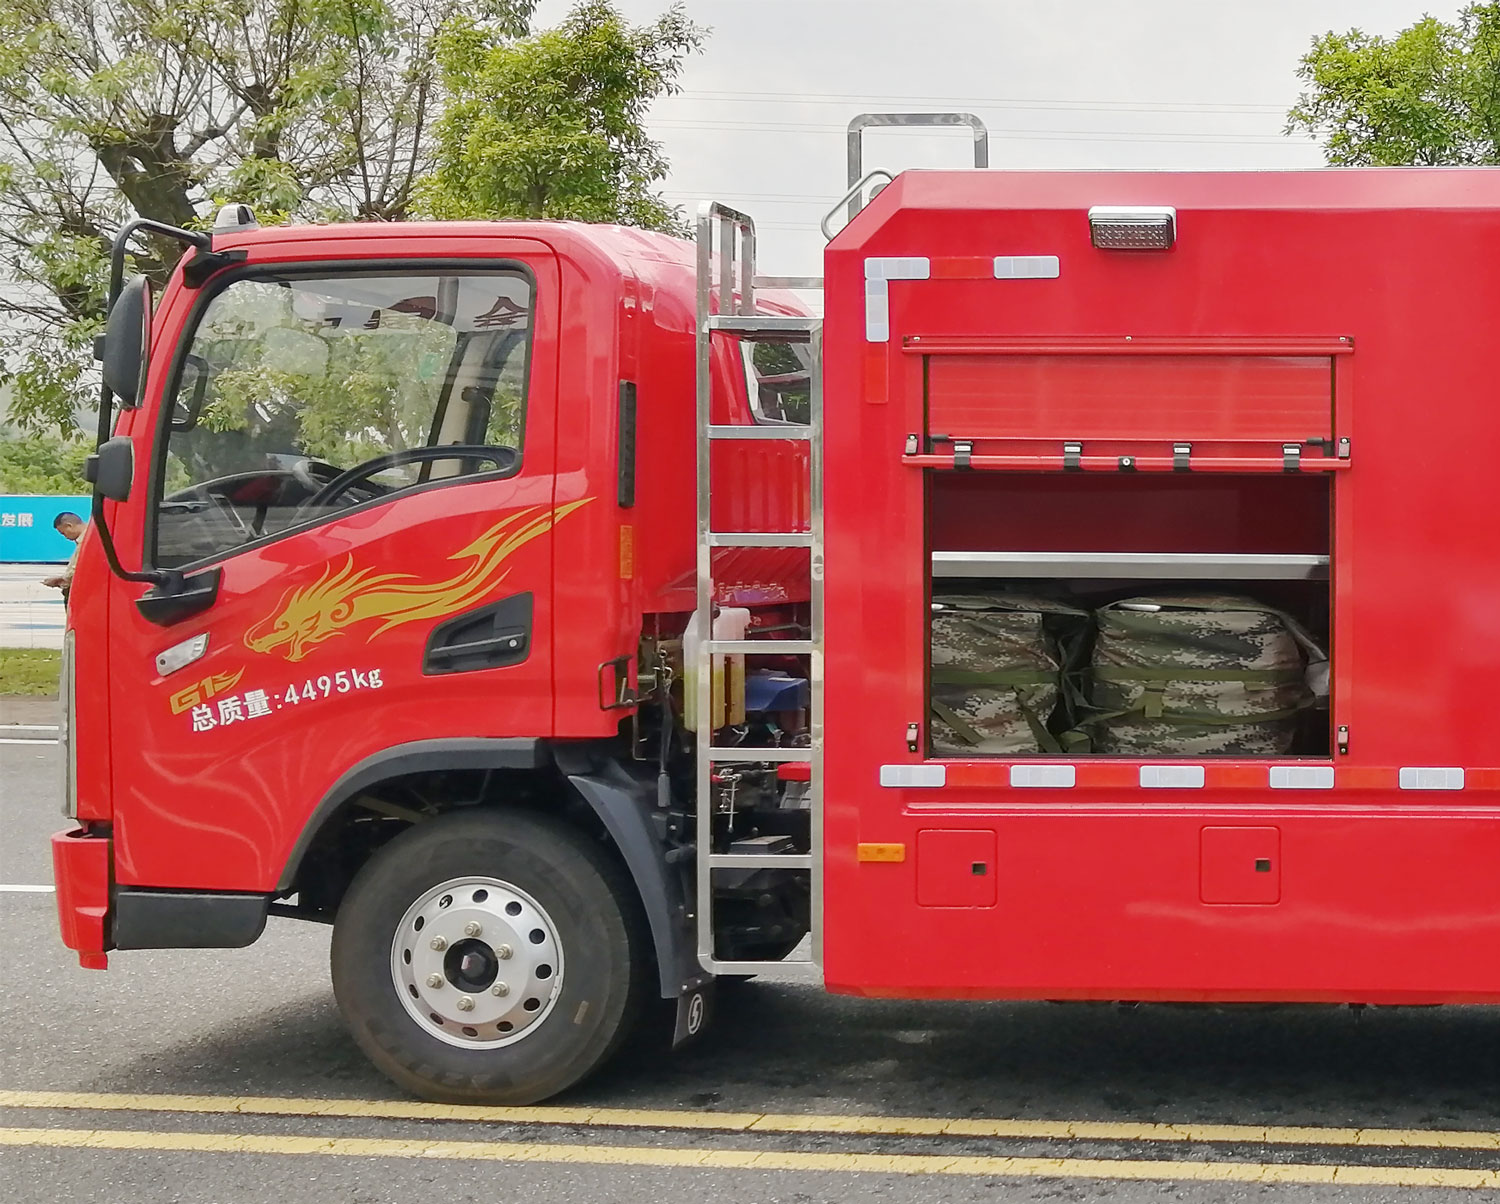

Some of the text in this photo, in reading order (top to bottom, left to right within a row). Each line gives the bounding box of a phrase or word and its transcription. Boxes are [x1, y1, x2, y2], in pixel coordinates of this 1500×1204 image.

[1, 512, 33, 527] 发展
[192, 668, 383, 732] 总质量:4495kg
